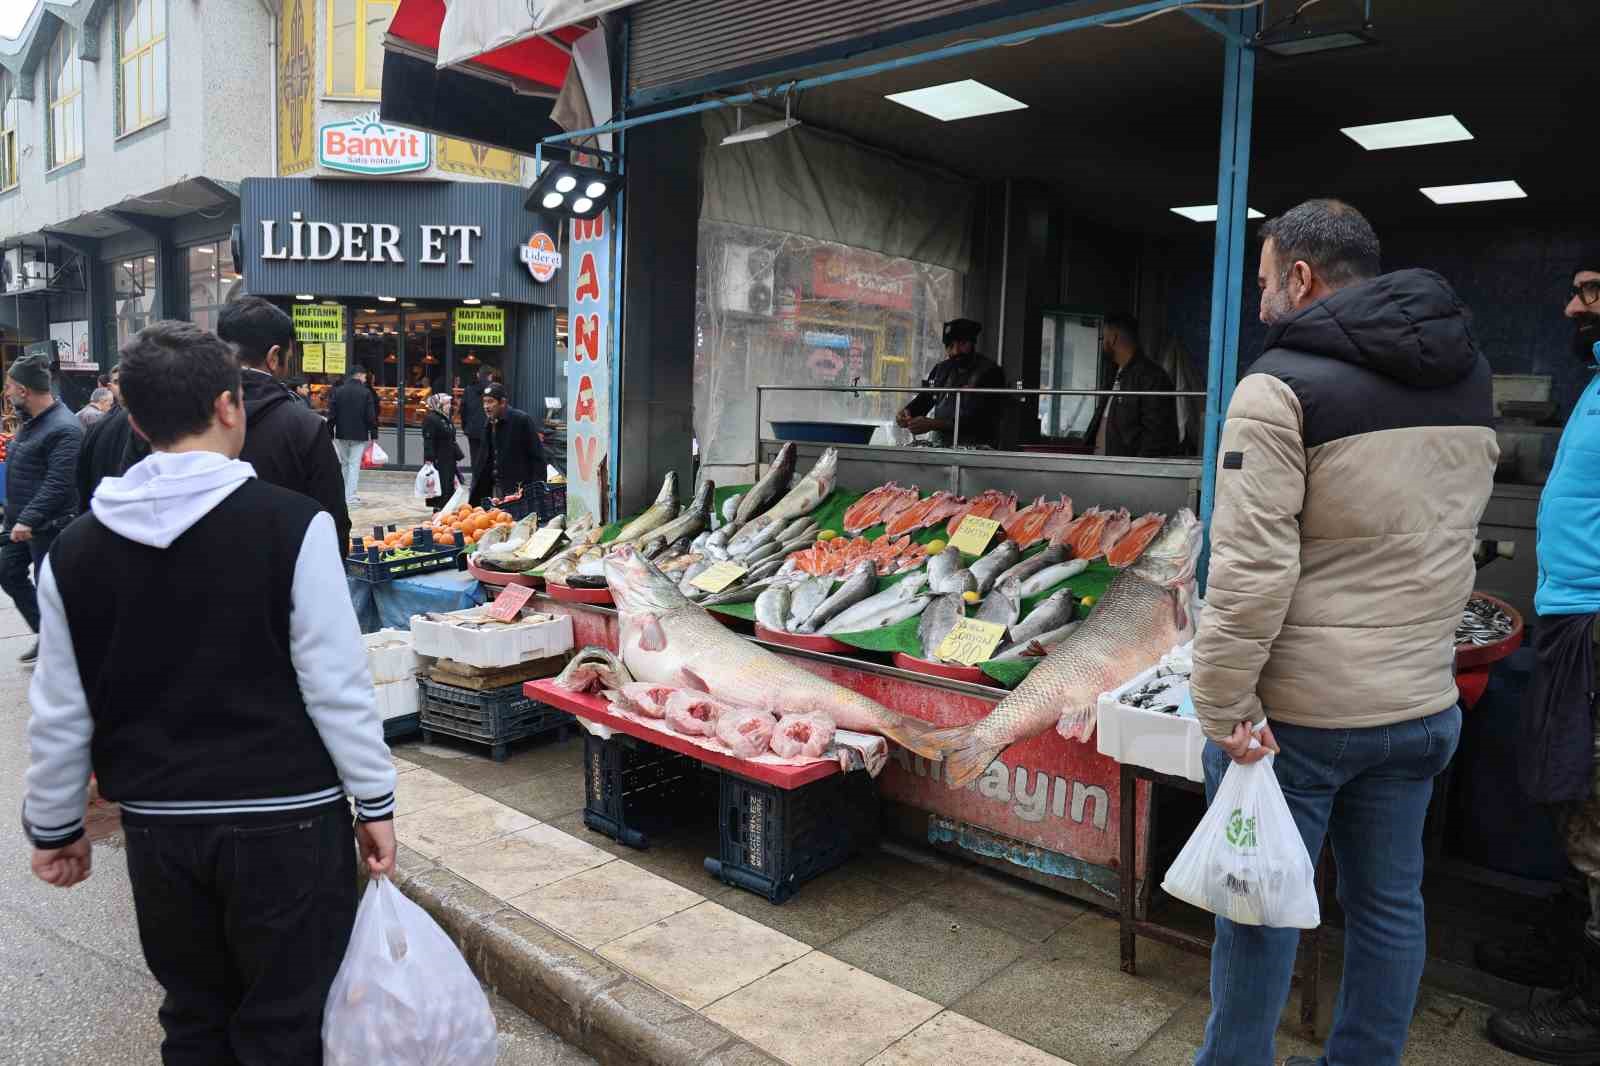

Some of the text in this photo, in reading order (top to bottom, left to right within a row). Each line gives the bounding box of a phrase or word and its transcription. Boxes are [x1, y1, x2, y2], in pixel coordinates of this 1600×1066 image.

[326, 130, 419, 157] Banvit
[261, 211, 482, 264] LİDER ET
[458, 309, 502, 320] HAFTANIN
